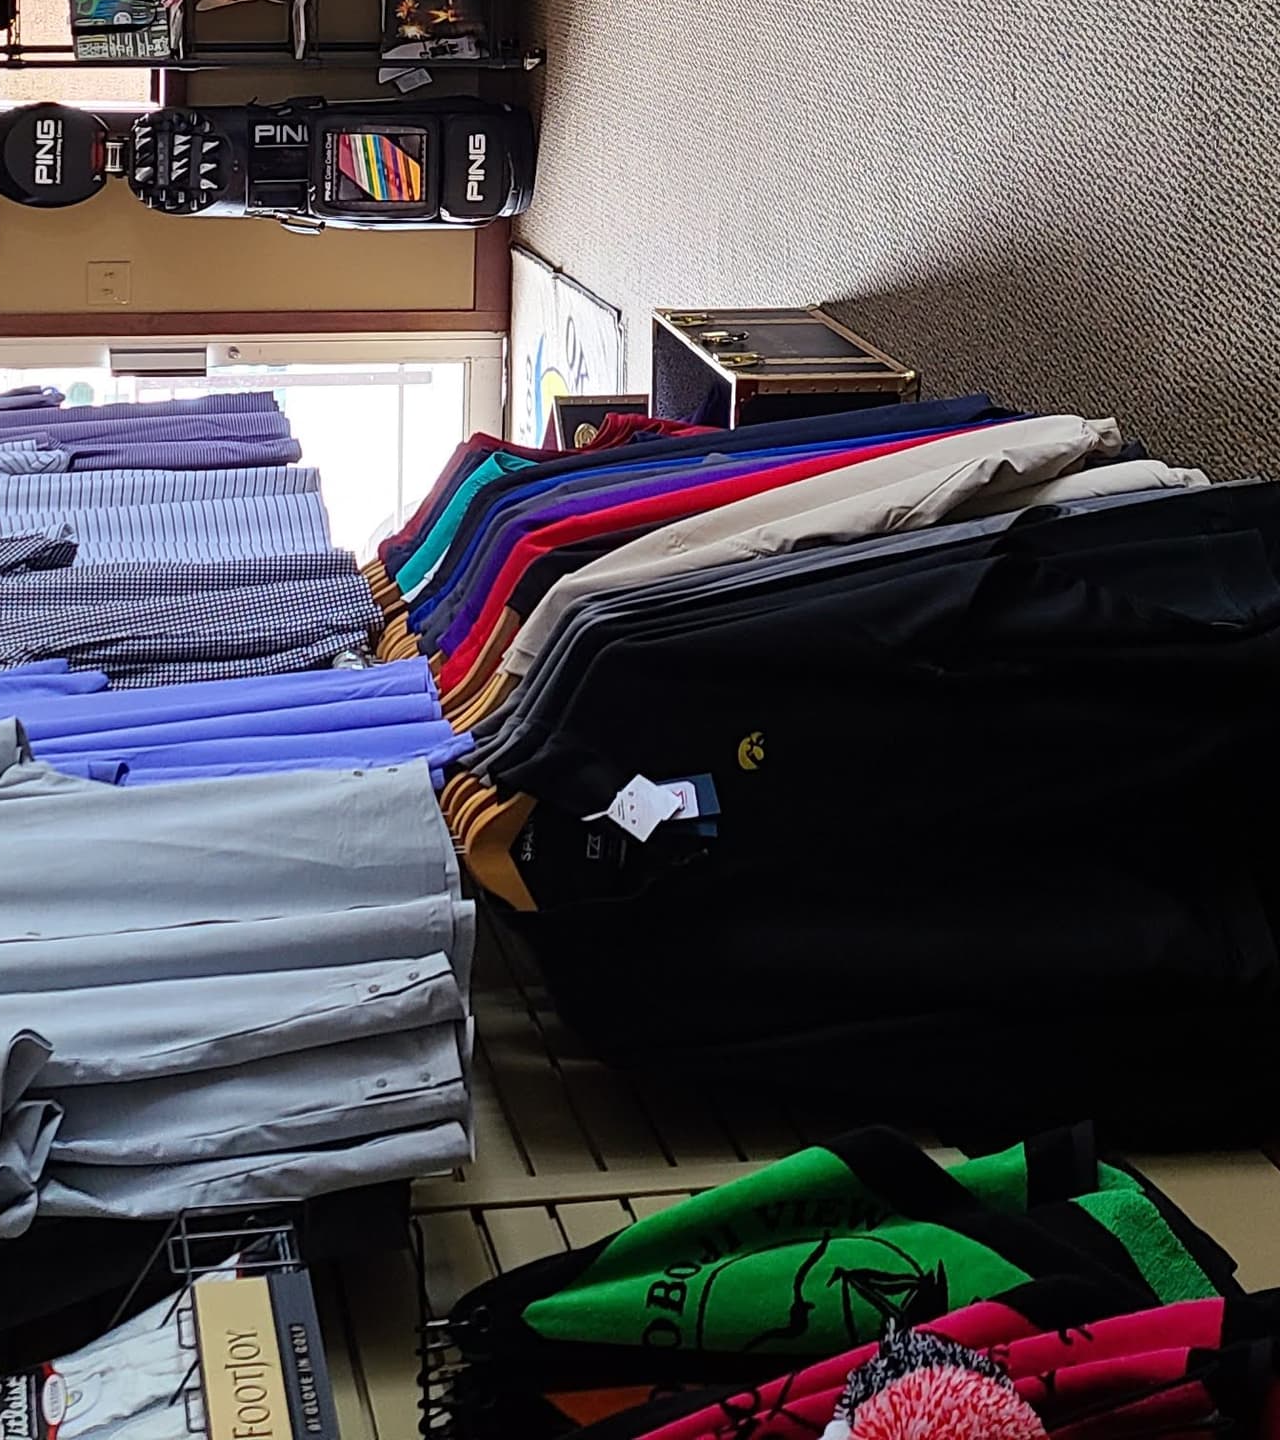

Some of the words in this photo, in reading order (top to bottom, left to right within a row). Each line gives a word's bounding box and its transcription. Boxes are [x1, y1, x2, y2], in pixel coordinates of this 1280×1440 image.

[254, 124, 309, 143] PIN
[35, 120, 55, 184] PING
[466, 134, 486, 201] PING
[291, 1325, 308, 1353] GOLF
[297, 1358, 312, 1372] IN
[300, 1377, 319, 1415] GLOVE
